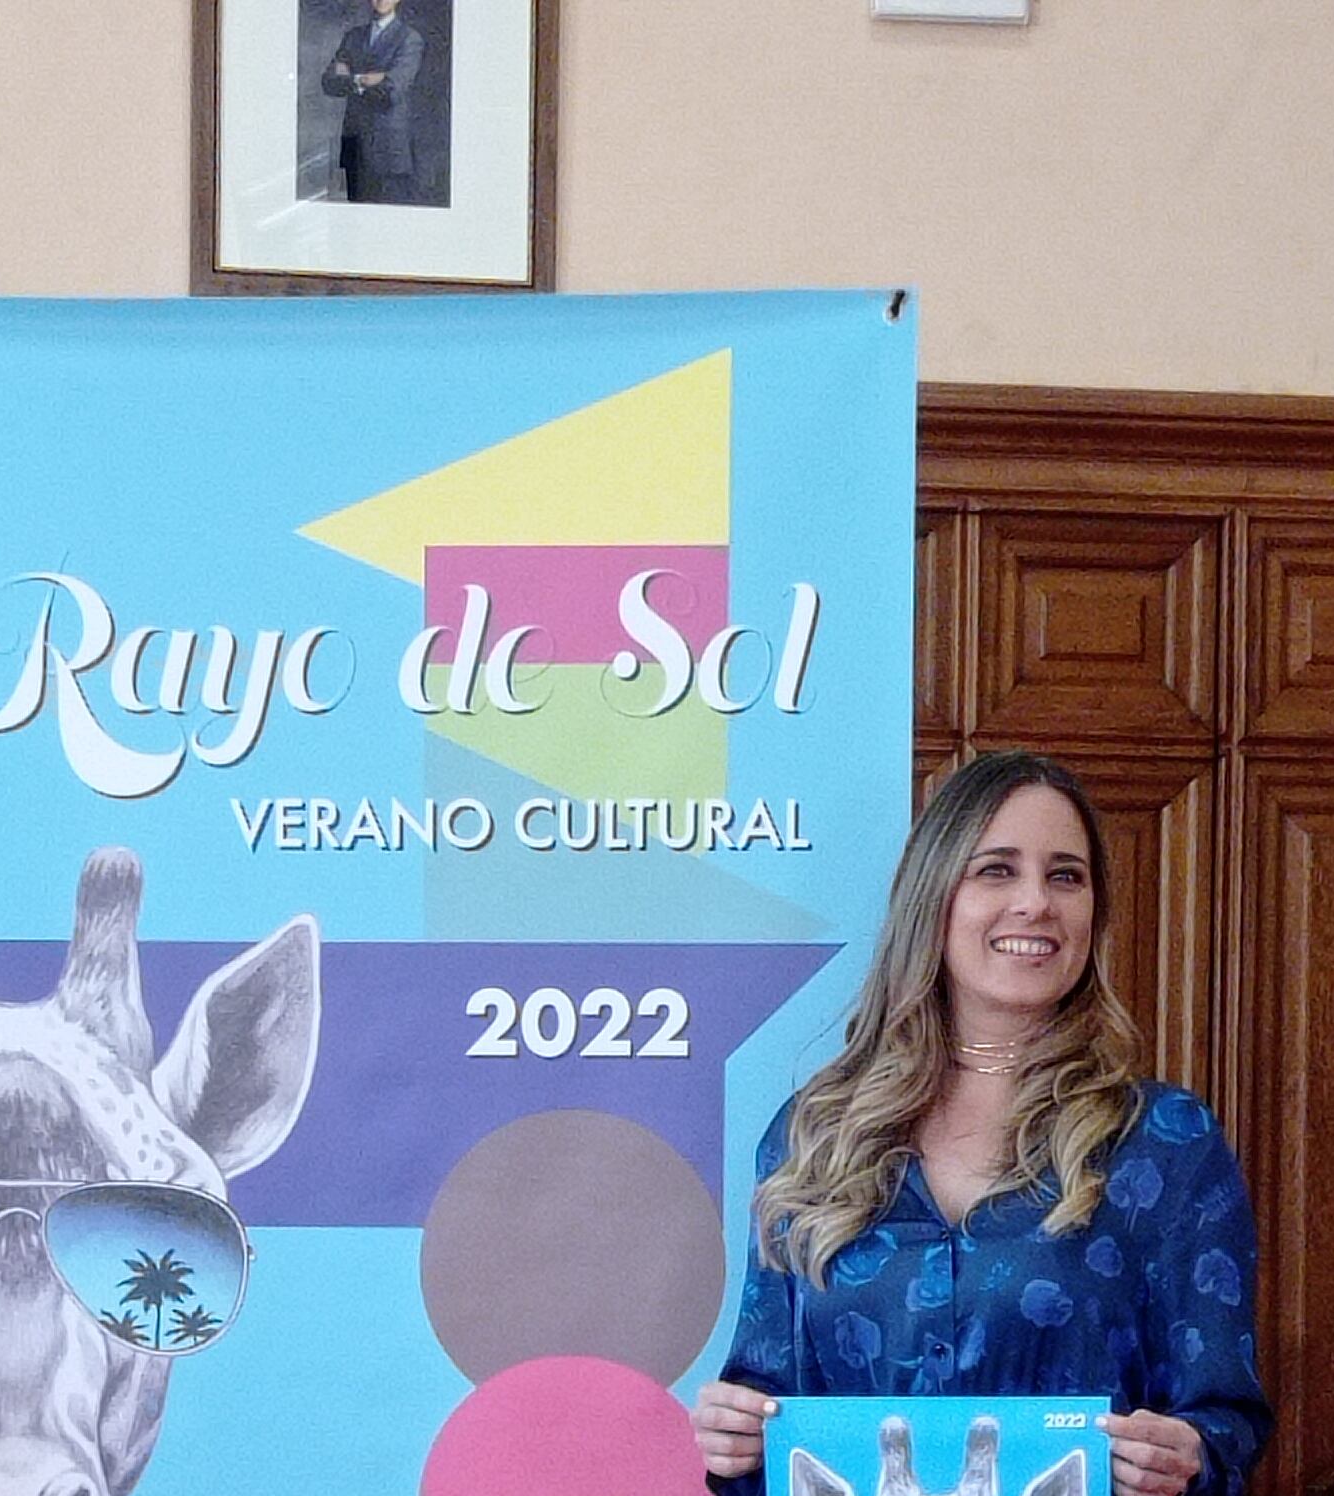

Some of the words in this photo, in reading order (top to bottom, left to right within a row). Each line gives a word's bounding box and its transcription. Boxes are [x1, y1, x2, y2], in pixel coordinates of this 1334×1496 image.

[398, 583, 557, 716] de
[599, 568, 820, 720] Sol
[229, 796, 494, 854] VERANO
[513, 796, 814, 854] CULTURAL
[465, 986, 691, 1060] 2022
[1043, 1412, 1087, 1429] 2022
